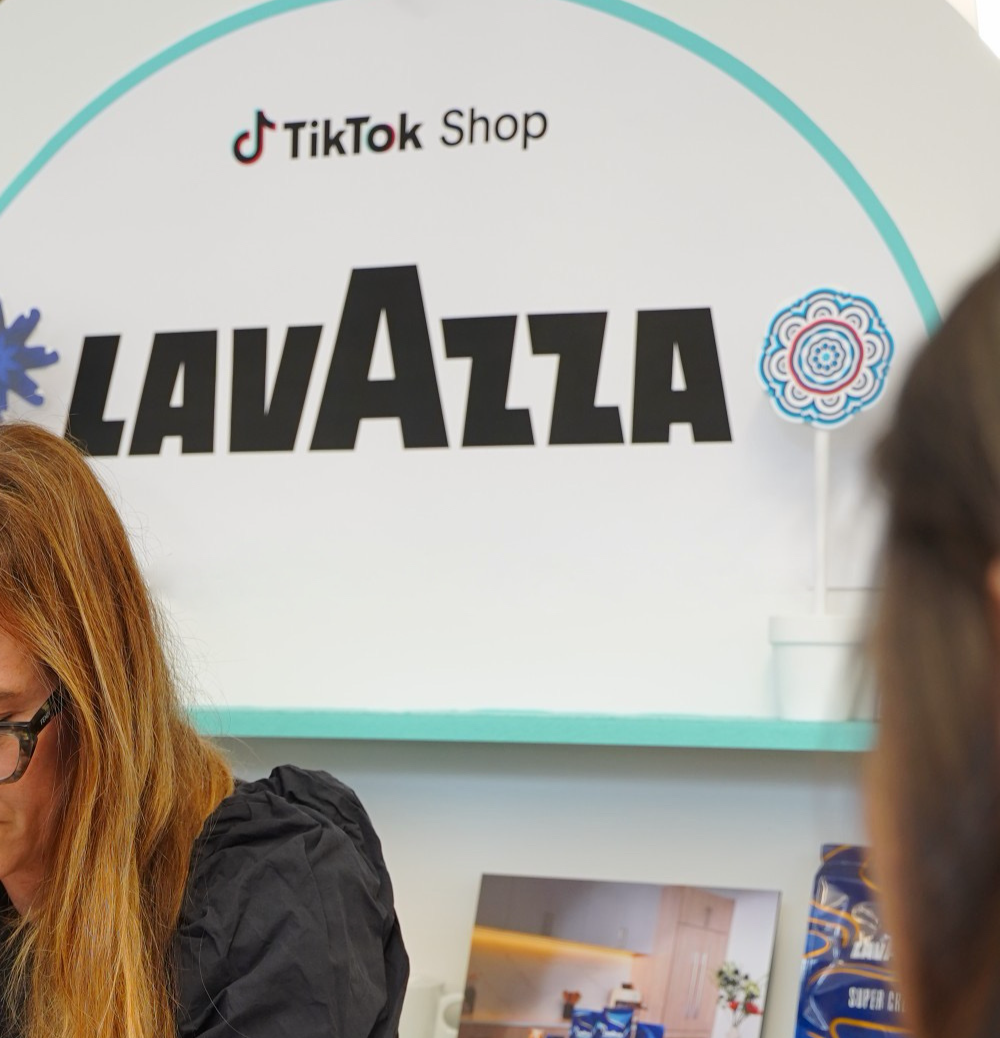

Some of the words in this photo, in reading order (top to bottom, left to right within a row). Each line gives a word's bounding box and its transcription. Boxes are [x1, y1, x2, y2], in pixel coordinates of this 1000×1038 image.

[283, 112, 423, 159] TikTok
[440, 107, 548, 150] Shop
[64, 264, 732, 457] LAVAZZA
[847, 986, 885, 1011] SUPER
